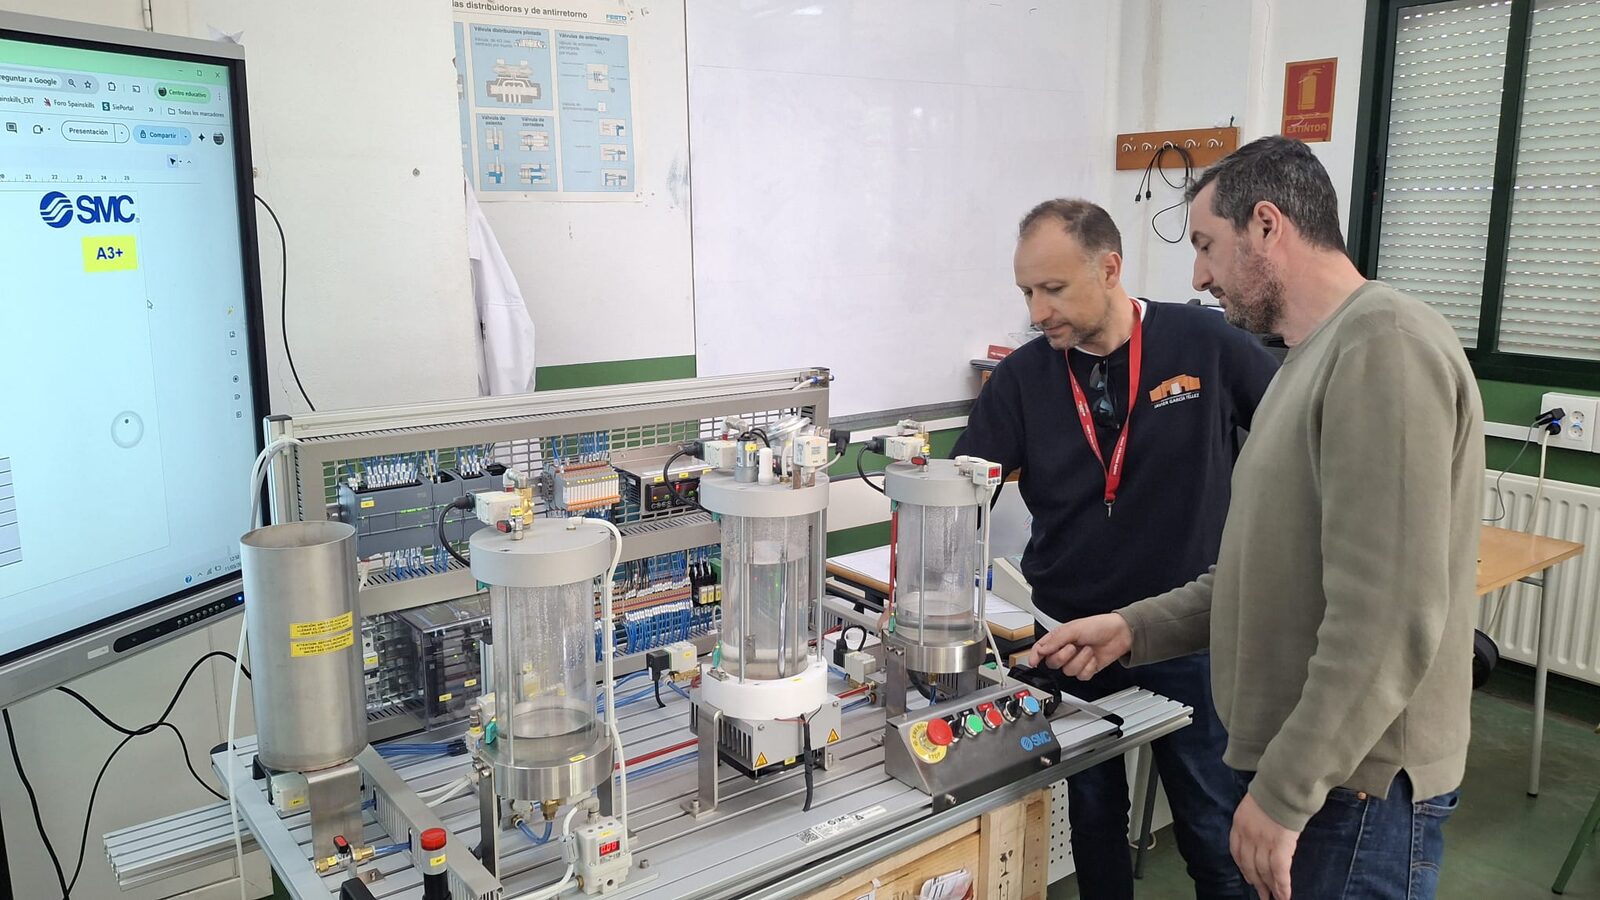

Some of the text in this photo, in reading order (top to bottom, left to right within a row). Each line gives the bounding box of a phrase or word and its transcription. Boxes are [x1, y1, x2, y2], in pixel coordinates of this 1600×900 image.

[466, 1, 522, 13] distribuidoras
[524, 7, 529, 15] y
[531, 7, 541, 15] de
[542, 8, 588, 19] antirretorno
[34, 76, 58, 86] Google
[169, 88, 184, 97] Centro
[53, 99, 95, 109] Foro Spainskills
[112, 104, 135, 112] SiePortal
[178, 108, 192, 117] Todos
[68, 127, 109, 136] Presentación
[1286, 123, 1328, 134] EXTINTOR
[149, 131, 177, 140] Compartir
[76, 194, 136, 225] SMC
[96, 246, 124, 261] A3+
[1030, 730, 1052, 747] SMC
